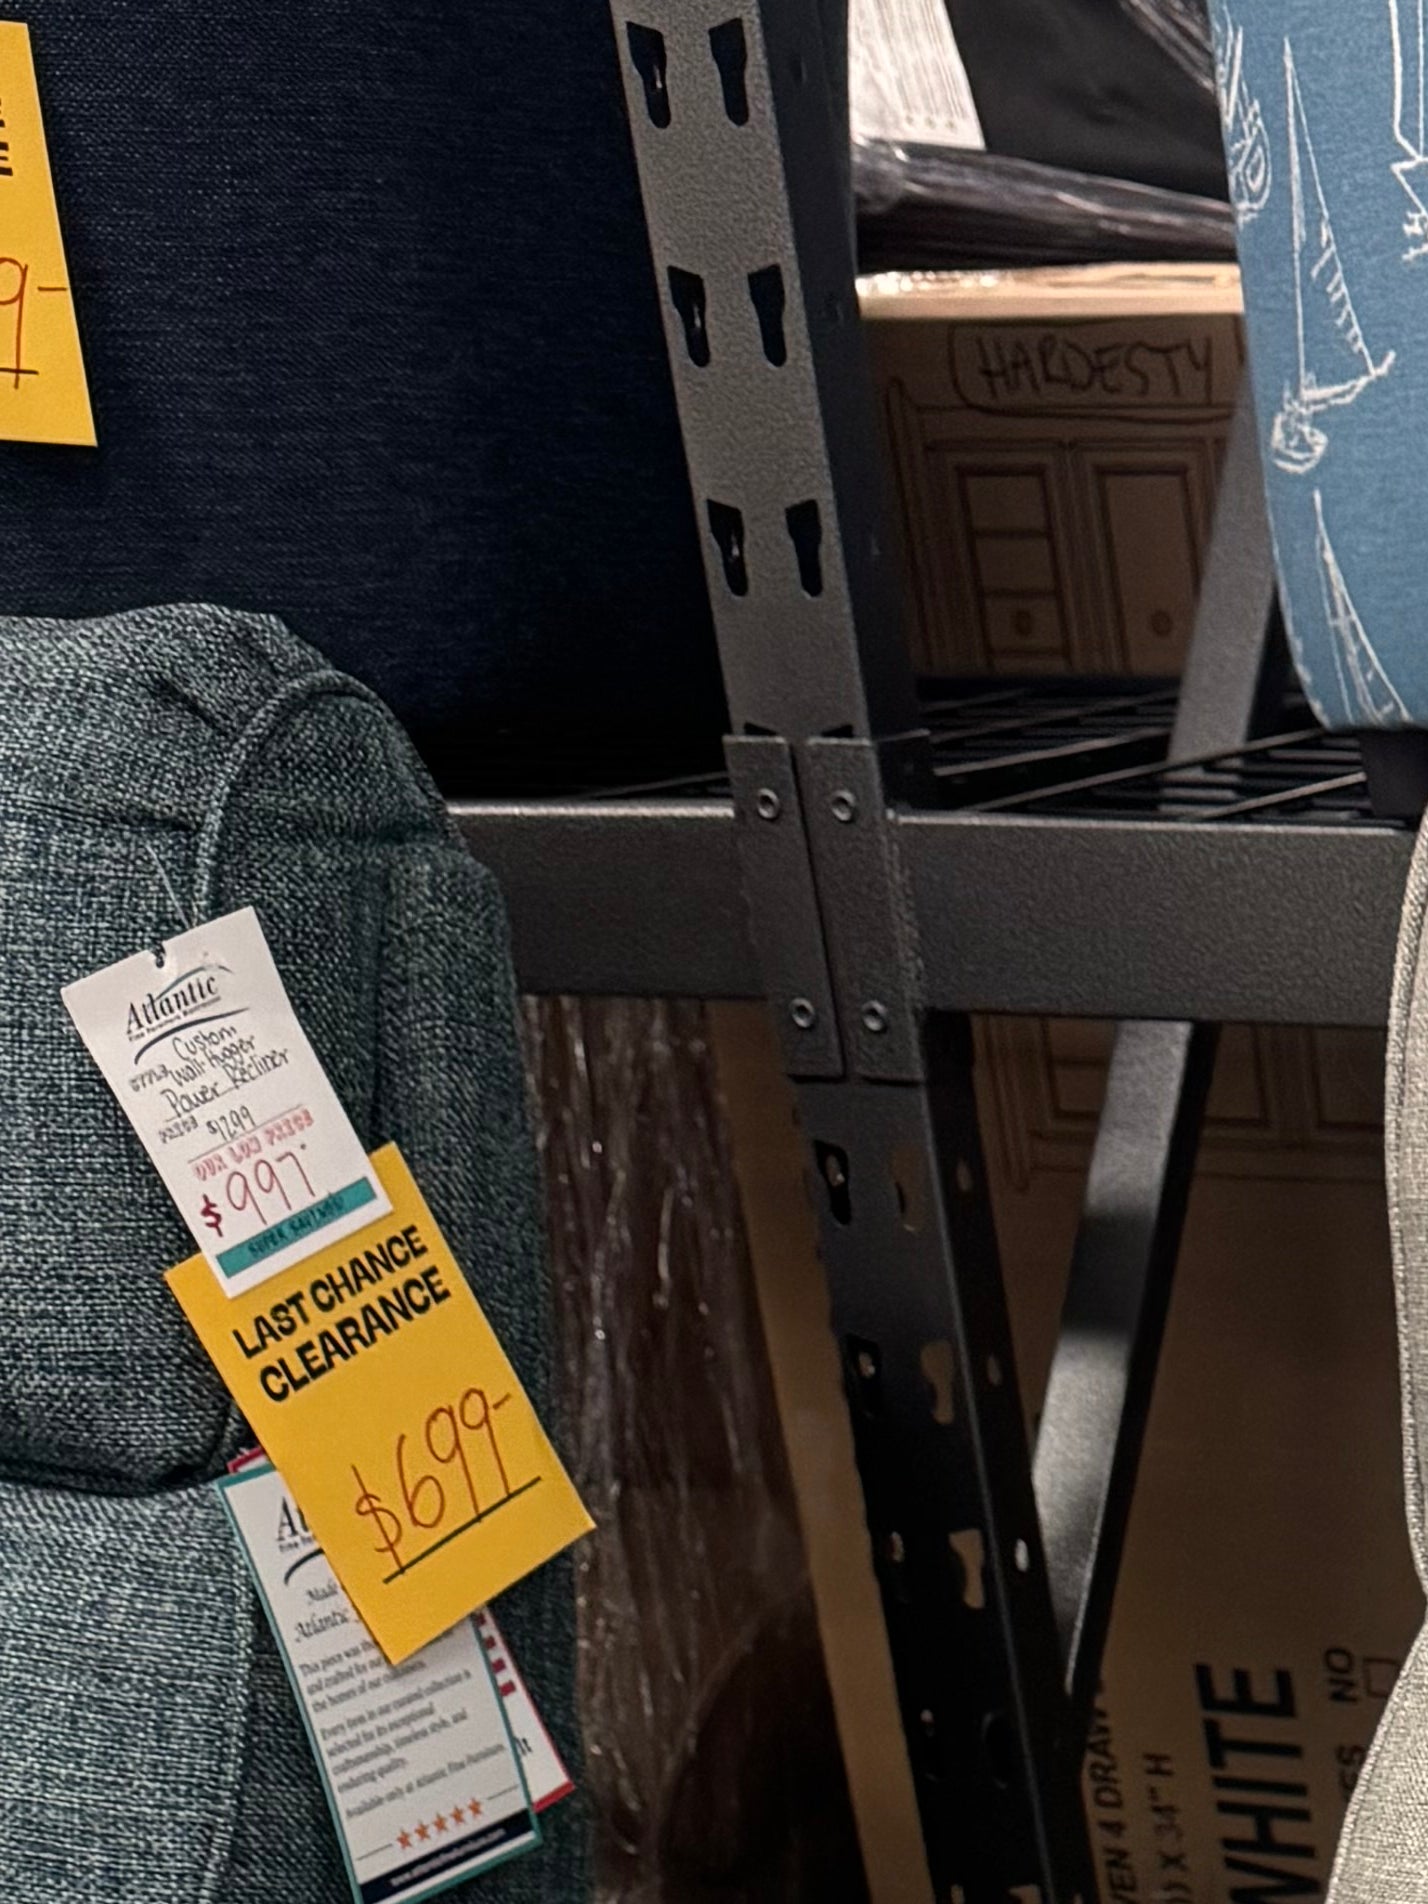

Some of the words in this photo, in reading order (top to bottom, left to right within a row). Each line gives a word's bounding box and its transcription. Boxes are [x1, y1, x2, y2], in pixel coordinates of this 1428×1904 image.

[976, 333, 1213, 404] HARDESTY
[126, 975, 219, 1035] Atlantic
[172, 1025, 238, 1062] Custom
[160, 1081, 220, 1118] Power
[233, 1291, 312, 1359] LAST
[309, 1224, 429, 1314] CHANCE
[259, 1265, 452, 1402] CLEARANCE
[1325, 1647, 1358, 1703] NO
[1088, 1682, 1124, 1810] DRAW
[1143, 1753, 1174, 1776] H
[1098, 1819, 1126, 1837] 4
[1161, 1853, 1190, 1871] X
